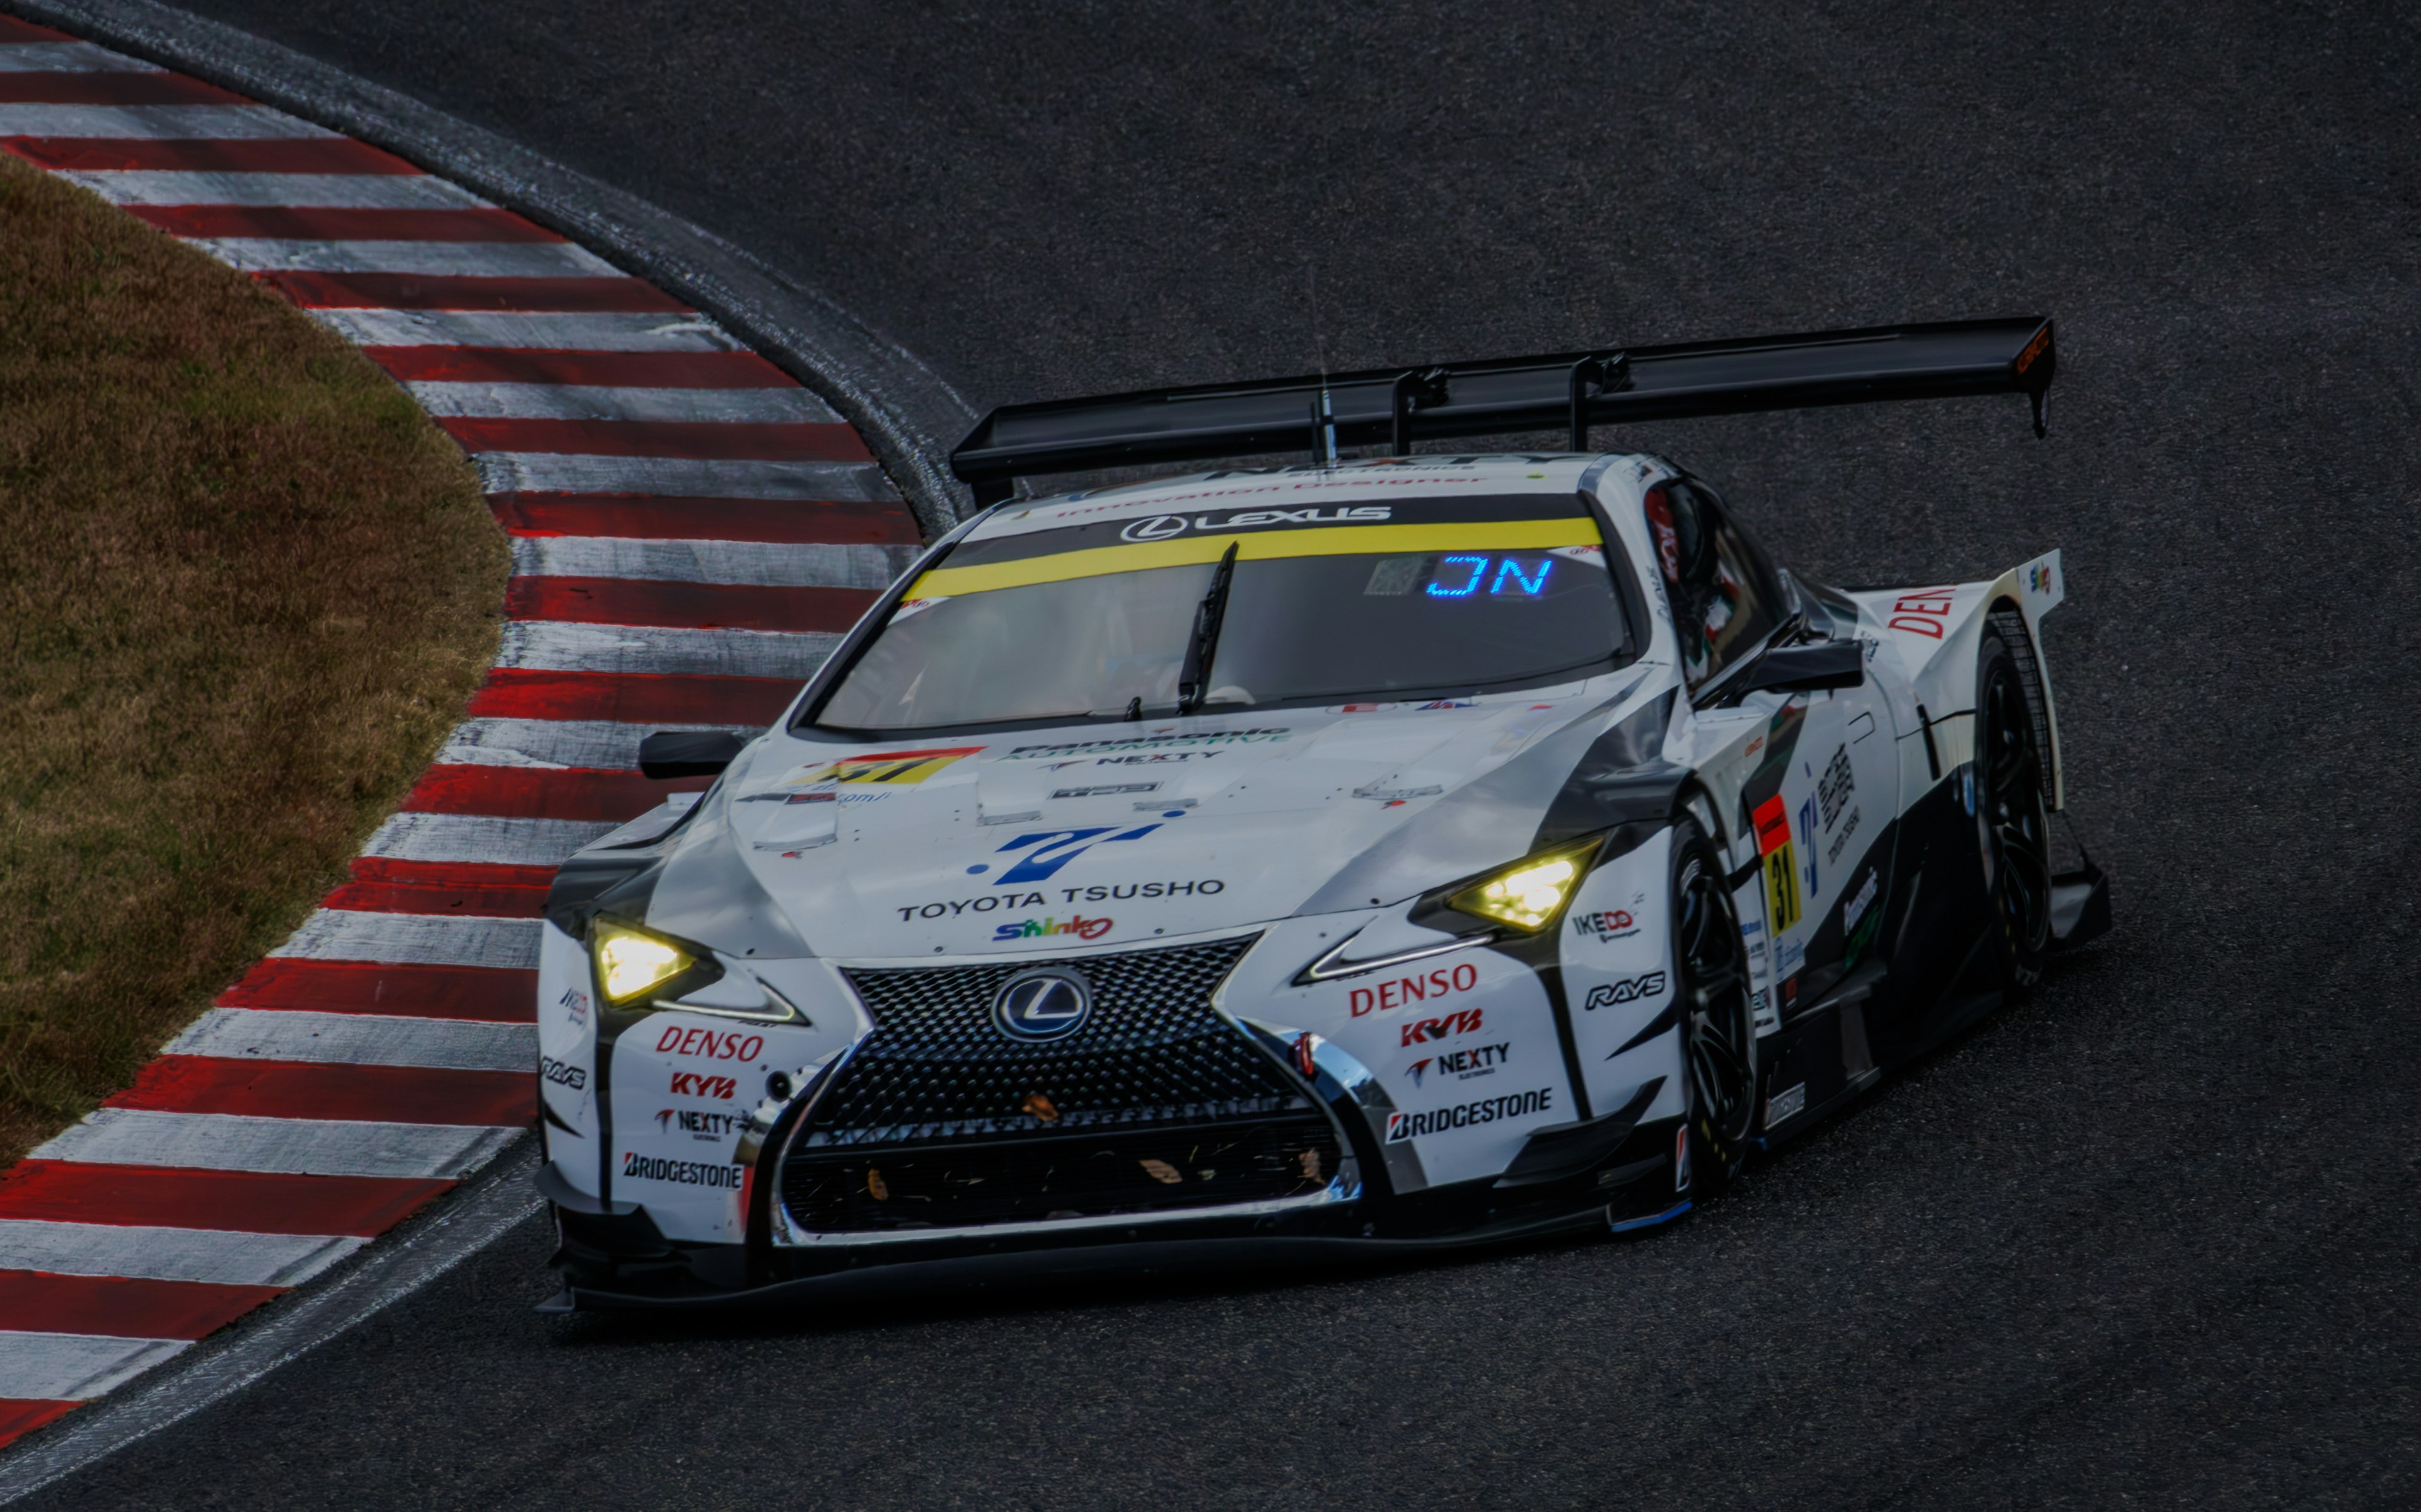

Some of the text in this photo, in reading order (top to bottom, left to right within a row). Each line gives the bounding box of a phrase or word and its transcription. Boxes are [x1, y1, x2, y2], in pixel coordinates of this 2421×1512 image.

[1057, 477, 1488, 517] Innovation Designer
[1193, 507, 1391, 530] LEXUS
[995, 735, 1293, 761] AUTOMOTIVE
[1010, 727, 1291, 754] Panasonic
[1096, 751, 1226, 765] NEXTY
[898, 880, 1224, 921] TOYOTA TSUSHO
[1772, 846, 1794, 931] 31
[992, 915, 1113, 941] Shinko
[1349, 964, 1477, 1018] DENSO
[1586, 971, 1666, 1010] RAYS
[656, 1026, 764, 1062] DENSO
[1438, 1042, 1510, 1075] NEXTY
[671, 1072, 737, 1099] KYB
[678, 1109, 734, 1134] NEXTY
[1389, 1088, 1552, 1141] BRIDGESTONE
[624, 1152, 743, 1189] BRIDGESTONE
